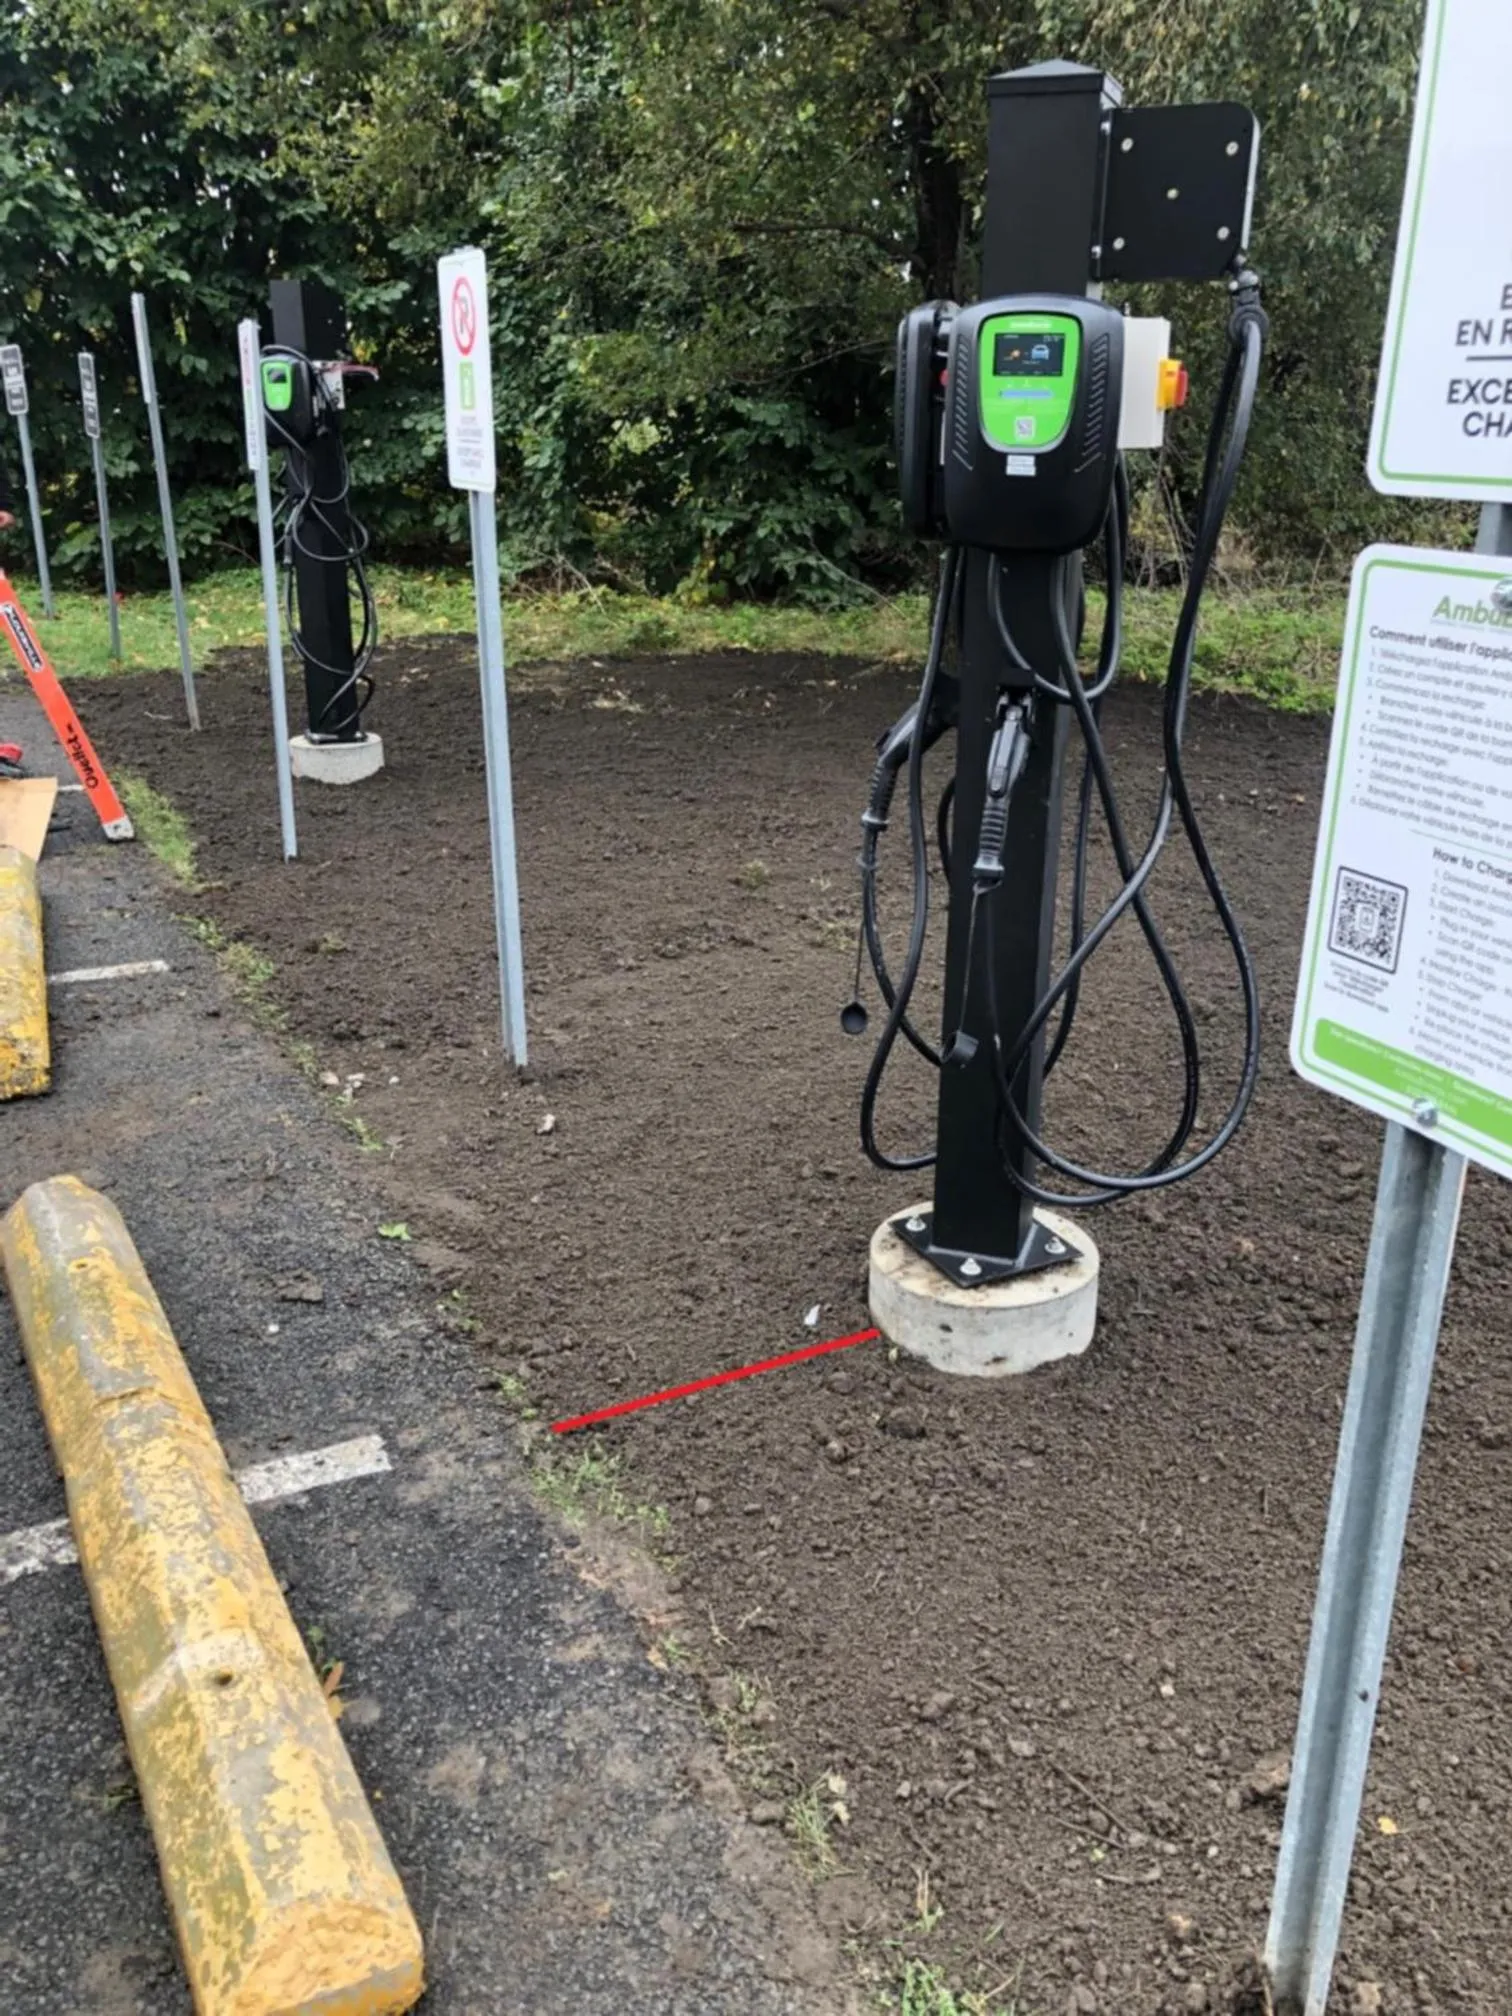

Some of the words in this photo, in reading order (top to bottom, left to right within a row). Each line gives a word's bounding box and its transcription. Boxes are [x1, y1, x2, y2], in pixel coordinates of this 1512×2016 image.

[1455, 318, 1493, 346] EN
[1369, 625, 1427, 647] Comment
[1433, 847, 1458, 865] How
[1461, 855, 1473, 870] to
